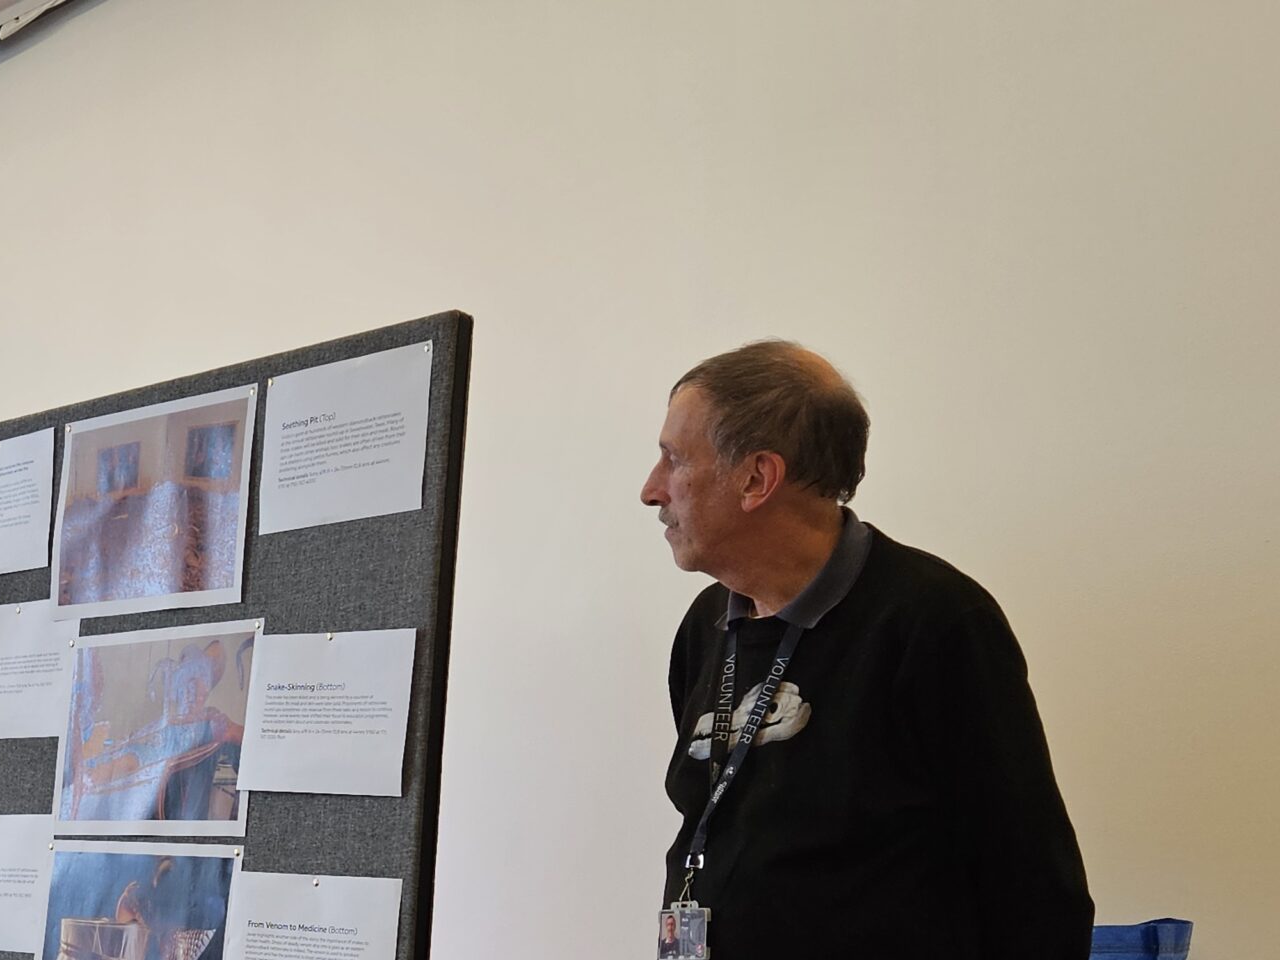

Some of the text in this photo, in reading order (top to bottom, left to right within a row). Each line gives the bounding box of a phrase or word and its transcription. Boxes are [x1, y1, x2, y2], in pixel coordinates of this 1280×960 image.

[713, 653, 736, 742] VOLUNTEER
[740, 657, 789, 744] VOLUNTEER
[248, 920, 265, 928] From
[265, 921, 289, 930] Venom
[298, 924, 327, 933] Medicine
[328, 926, 358, 935] (Bottom)
